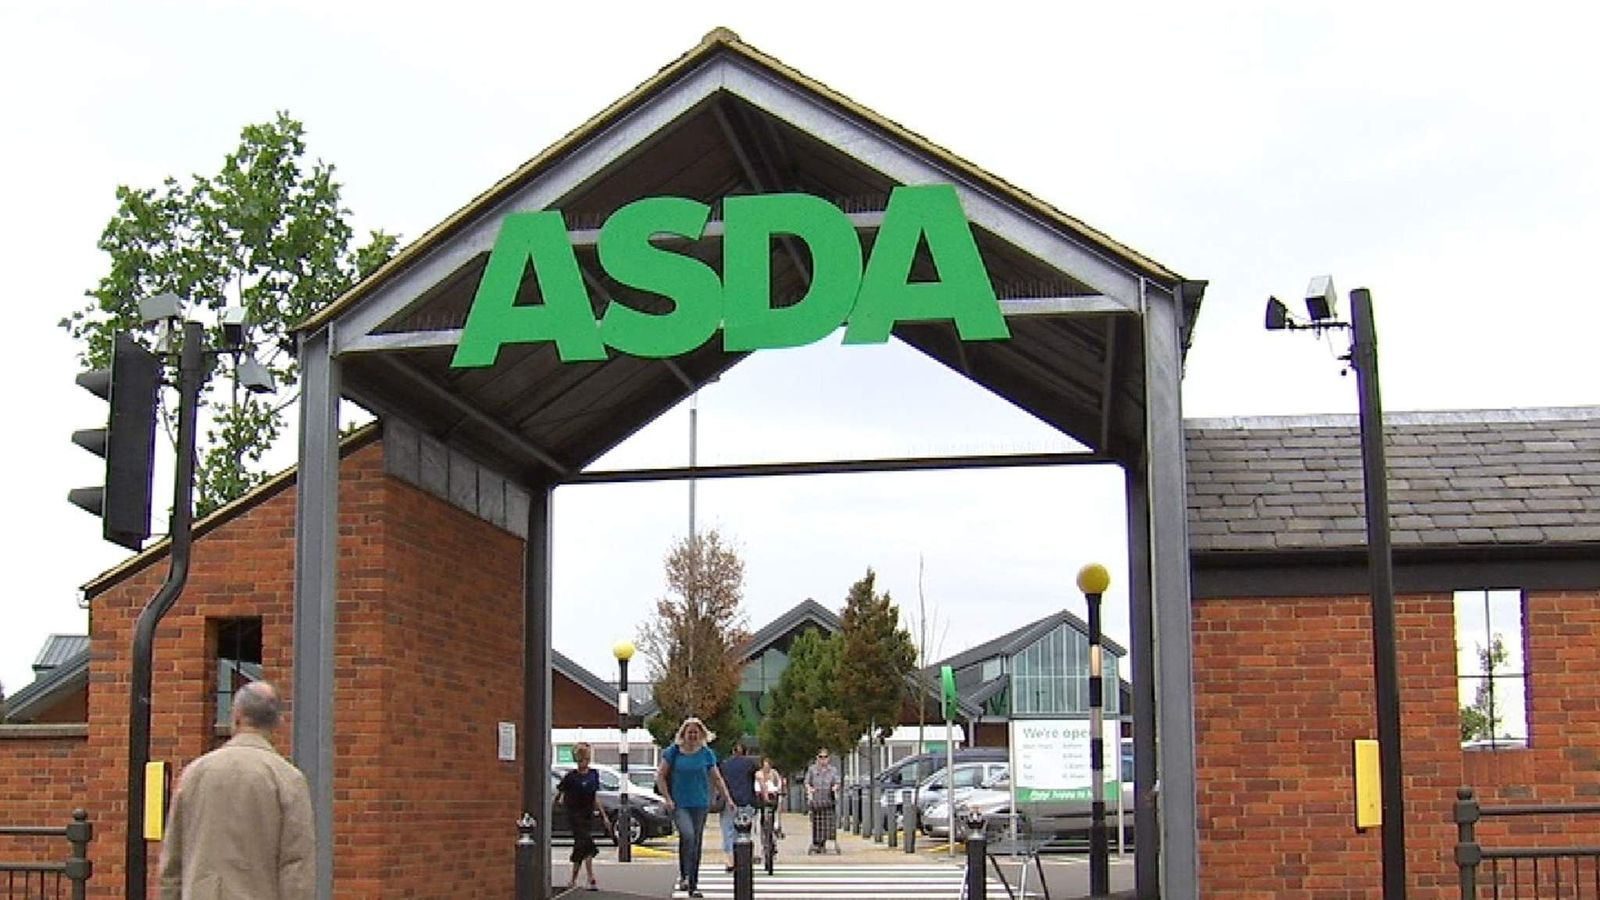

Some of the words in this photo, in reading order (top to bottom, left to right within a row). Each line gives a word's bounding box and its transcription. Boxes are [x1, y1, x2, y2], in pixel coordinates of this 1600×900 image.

[450, 184, 1011, 368] ASDA
[1023, 728, 1059, 738] We're
[1063, 728, 1092, 740] ope
